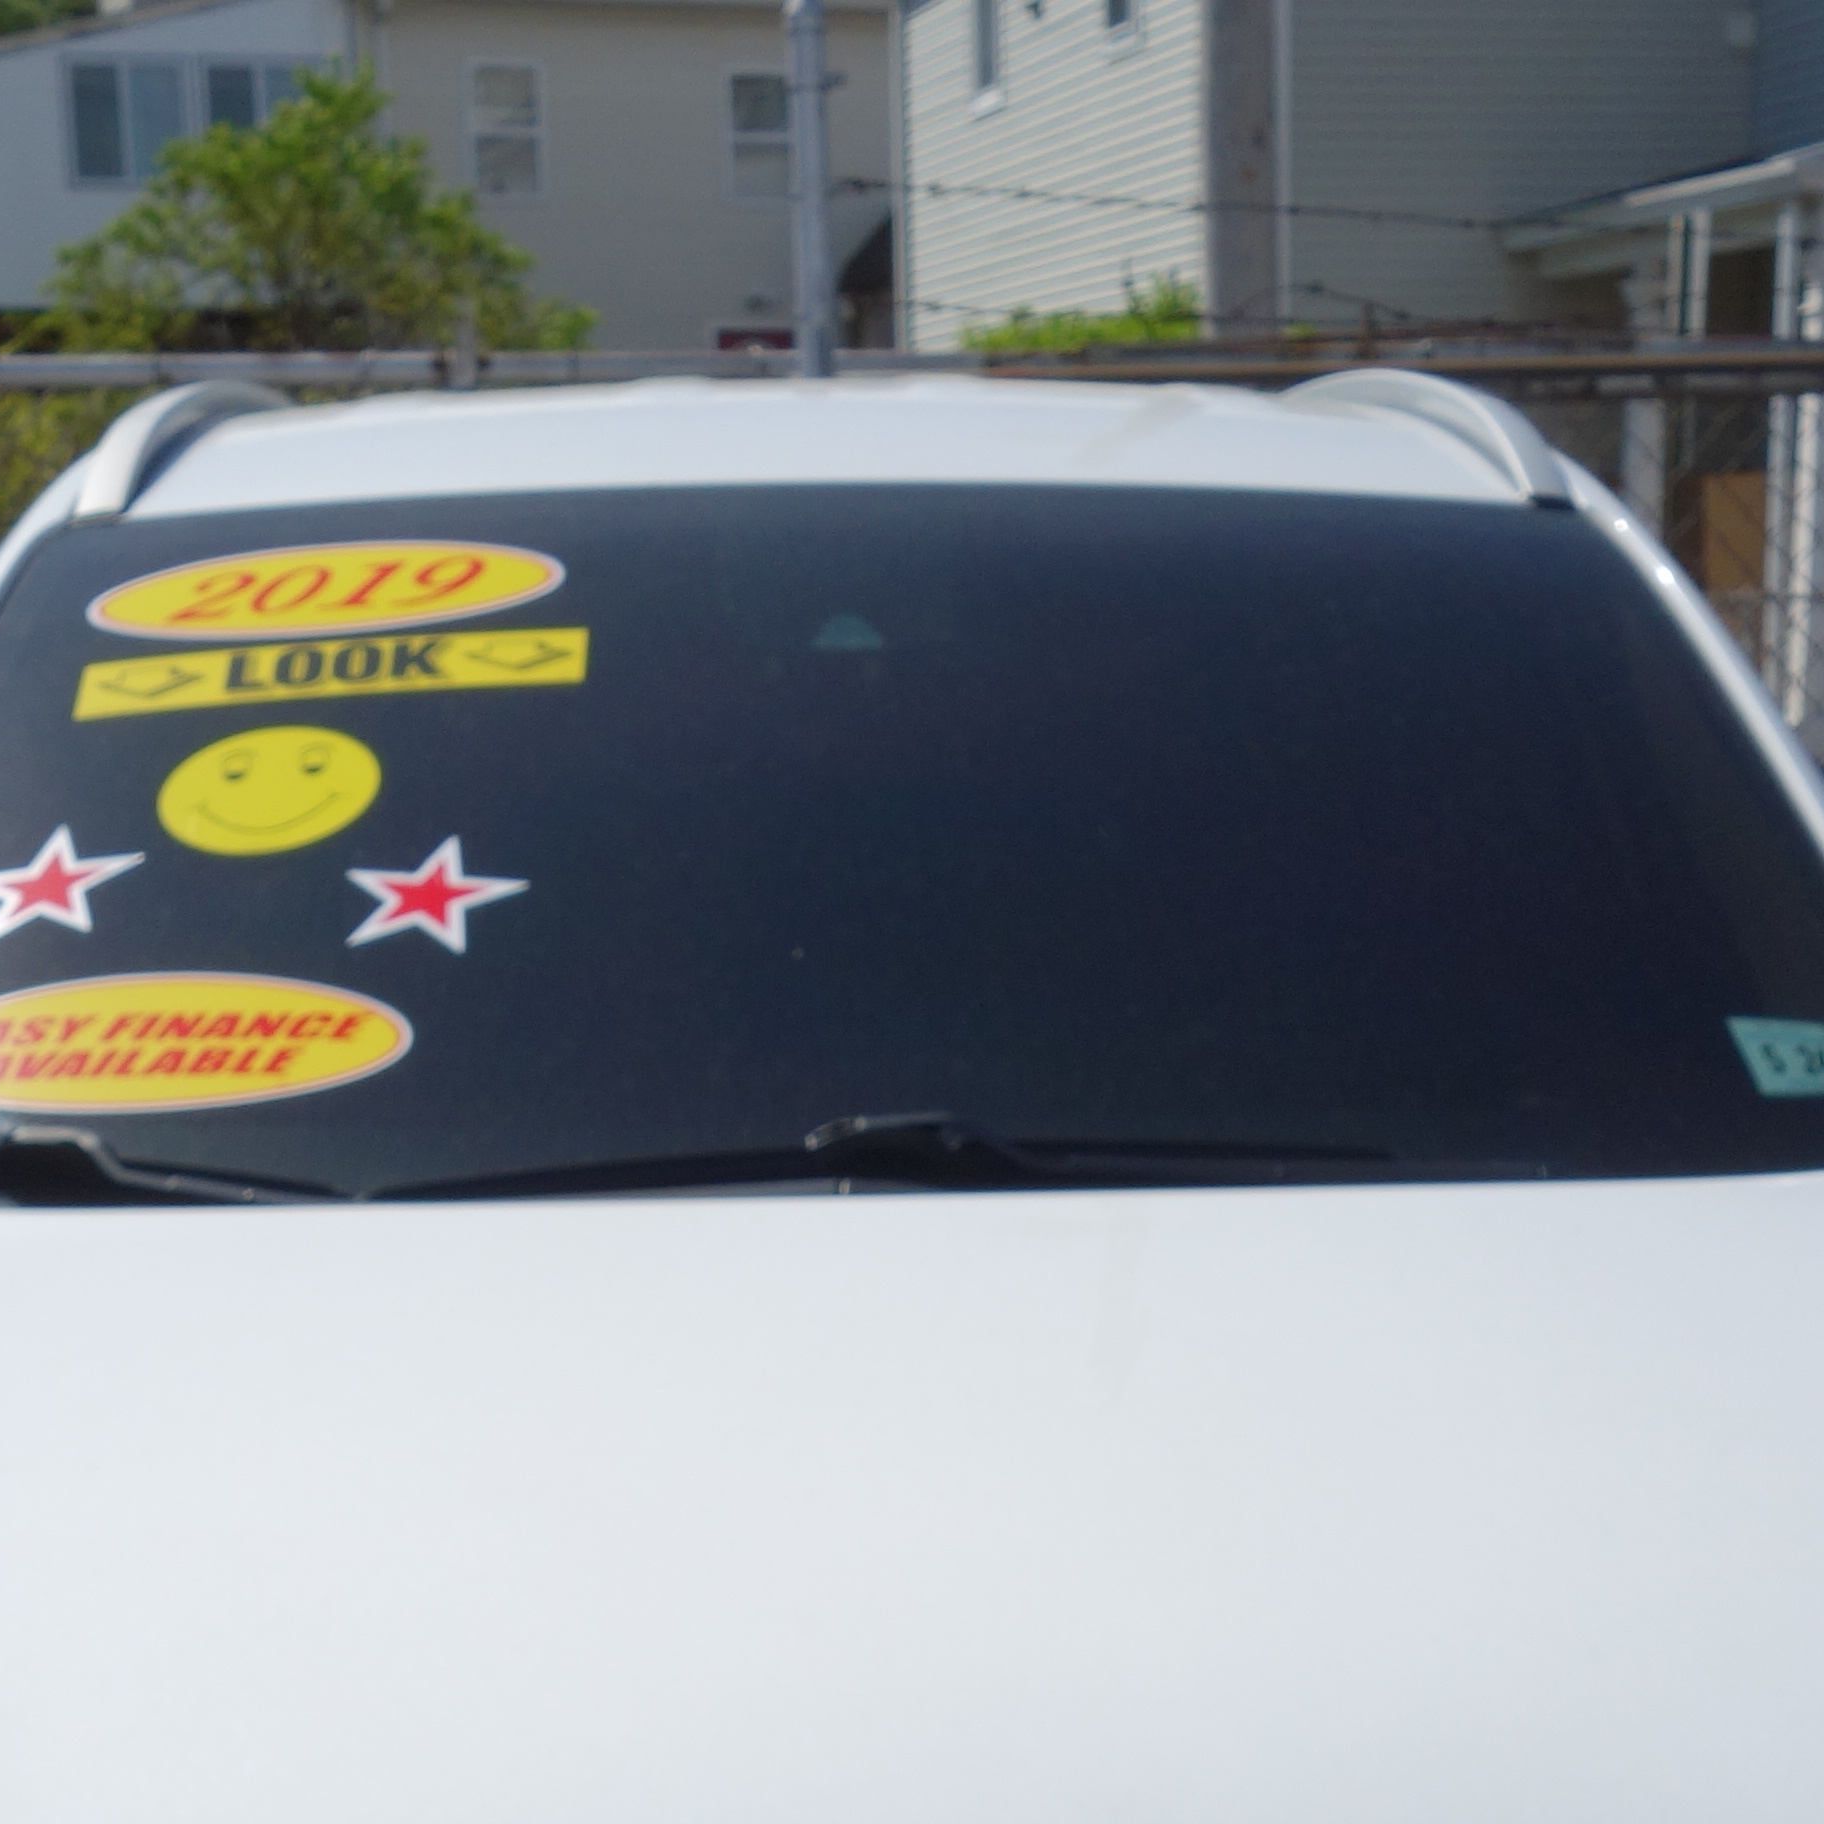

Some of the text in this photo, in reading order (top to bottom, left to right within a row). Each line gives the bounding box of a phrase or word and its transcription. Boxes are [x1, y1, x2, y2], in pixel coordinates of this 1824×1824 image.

[165, 554, 487, 625] 2019
[224, 638, 453, 694] LOOK
[101, 1010, 375, 1043] FINANCE
